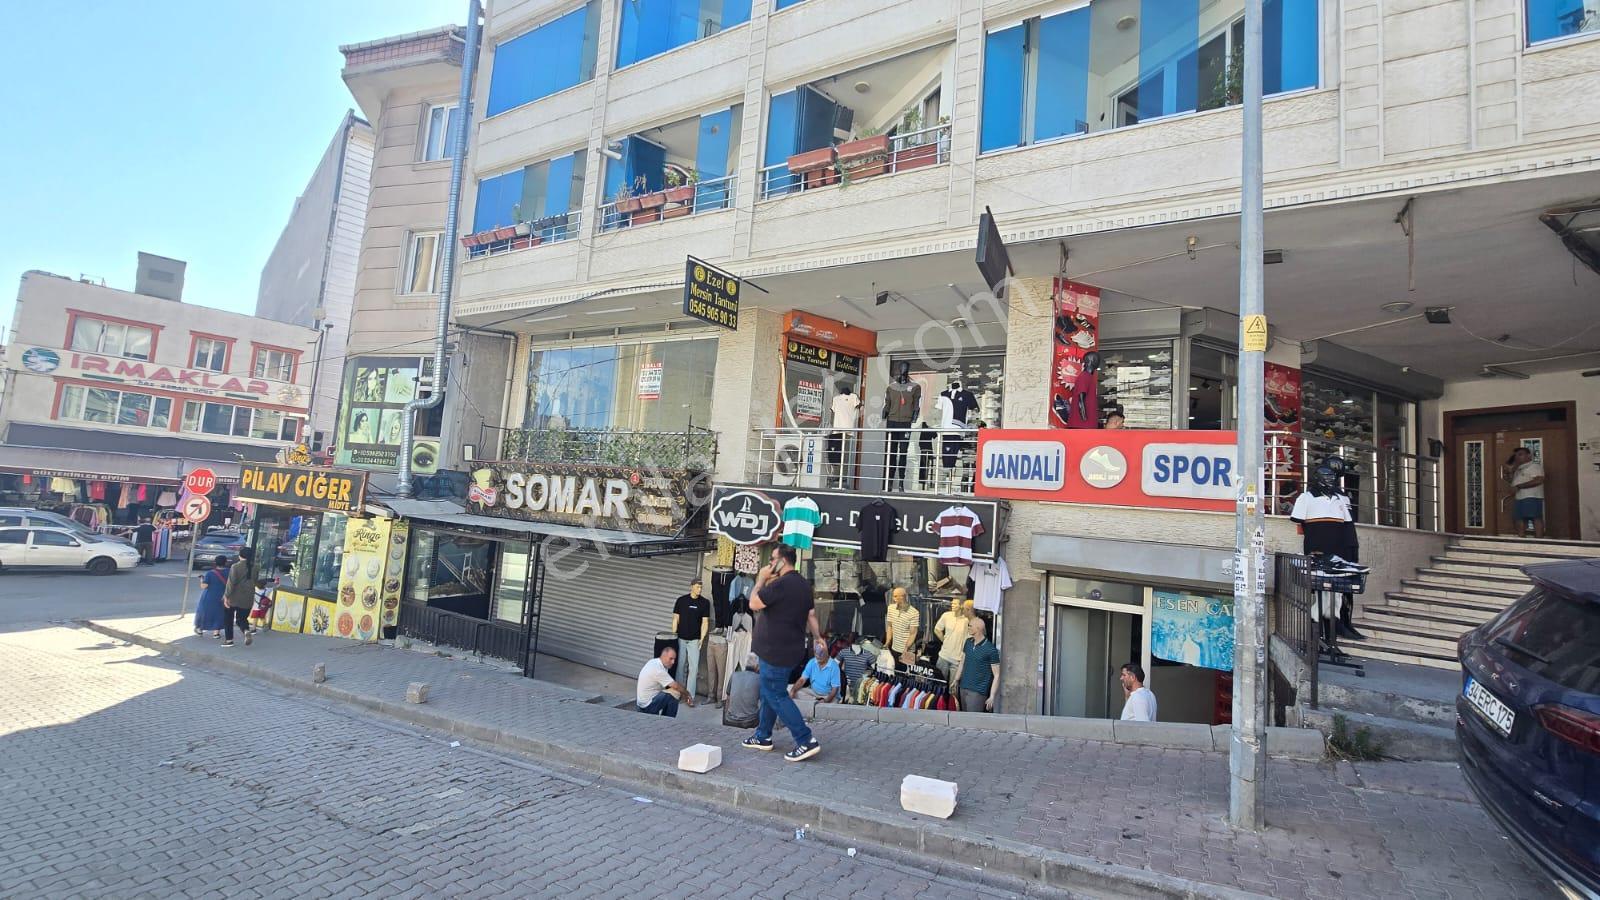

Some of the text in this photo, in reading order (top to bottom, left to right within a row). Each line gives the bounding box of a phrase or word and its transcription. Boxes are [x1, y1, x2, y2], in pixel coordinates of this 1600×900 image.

[706, 271, 725, 290] Ezel
[690, 282, 738, 312] Mersin Tantuni
[689, 299, 737, 328] 0545 905 90 33
[799, 345, 816, 355] Ezel
[70, 353, 270, 396] IRMAKLAR
[806, 439, 815, 474] BEKO
[985, 448, 1060, 482] JANDALİ
[1153, 454, 1232, 487] SPOR
[189, 475, 213, 488] DUR
[242, 466, 352, 501] PİLAV CİĞER
[505, 472, 631, 519] SOMAR
[328, 500, 350, 511] MİDYE
[353, 528, 381, 543] Ringo
[718, 510, 769, 535] WDJ
[1155, 596, 1233, 617] ESEN CA
[910, 664, 934, 676] TUPAC
[1468, 681, 1480, 702] 34
[1478, 688, 1498, 716] ERC
[1495, 704, 1514, 731] 175
